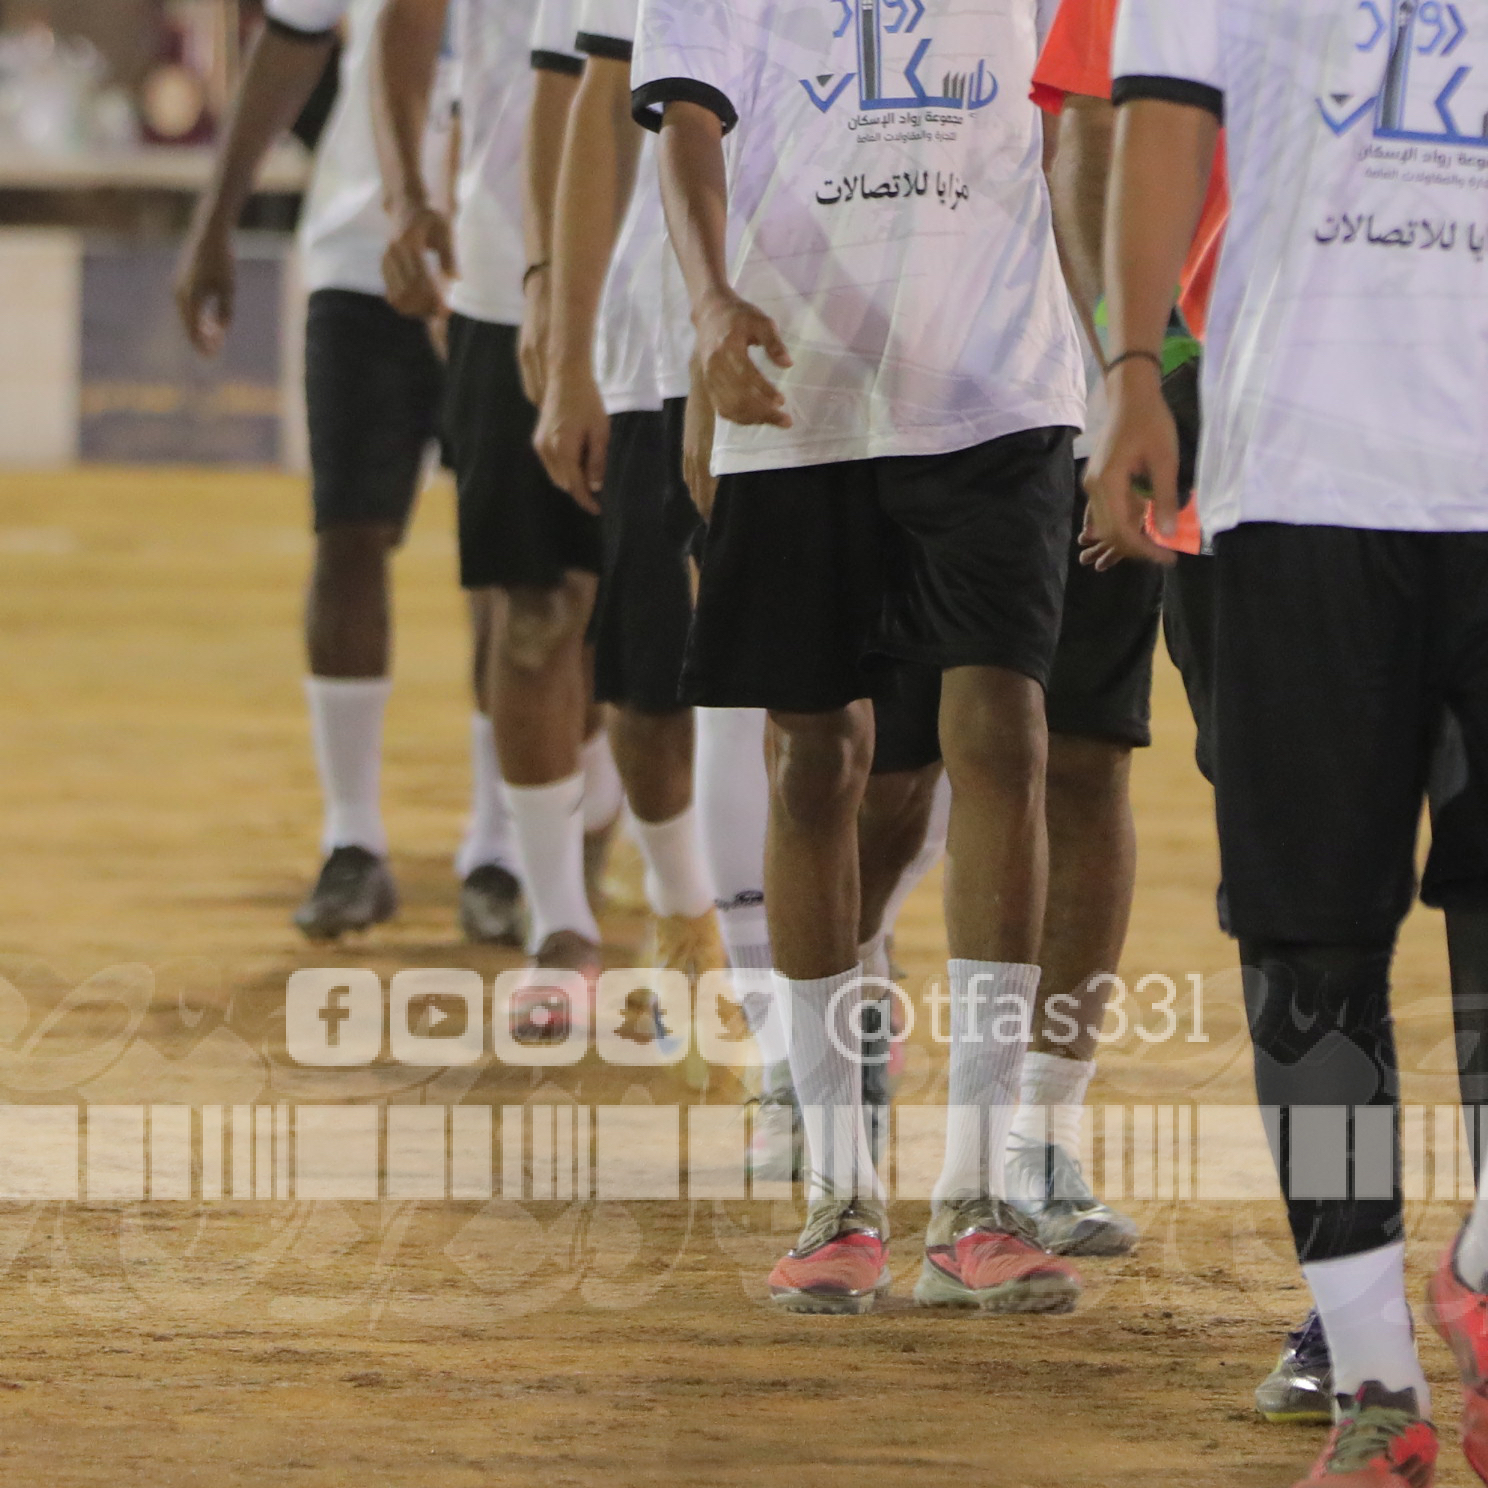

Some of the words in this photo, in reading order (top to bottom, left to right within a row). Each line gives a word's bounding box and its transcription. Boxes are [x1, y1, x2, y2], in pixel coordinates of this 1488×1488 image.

[815, 170, 928, 205] للاتصالات
[936, 171, 970, 210] مزايا
[1315, 213, 1457, 251] للاتصالات
